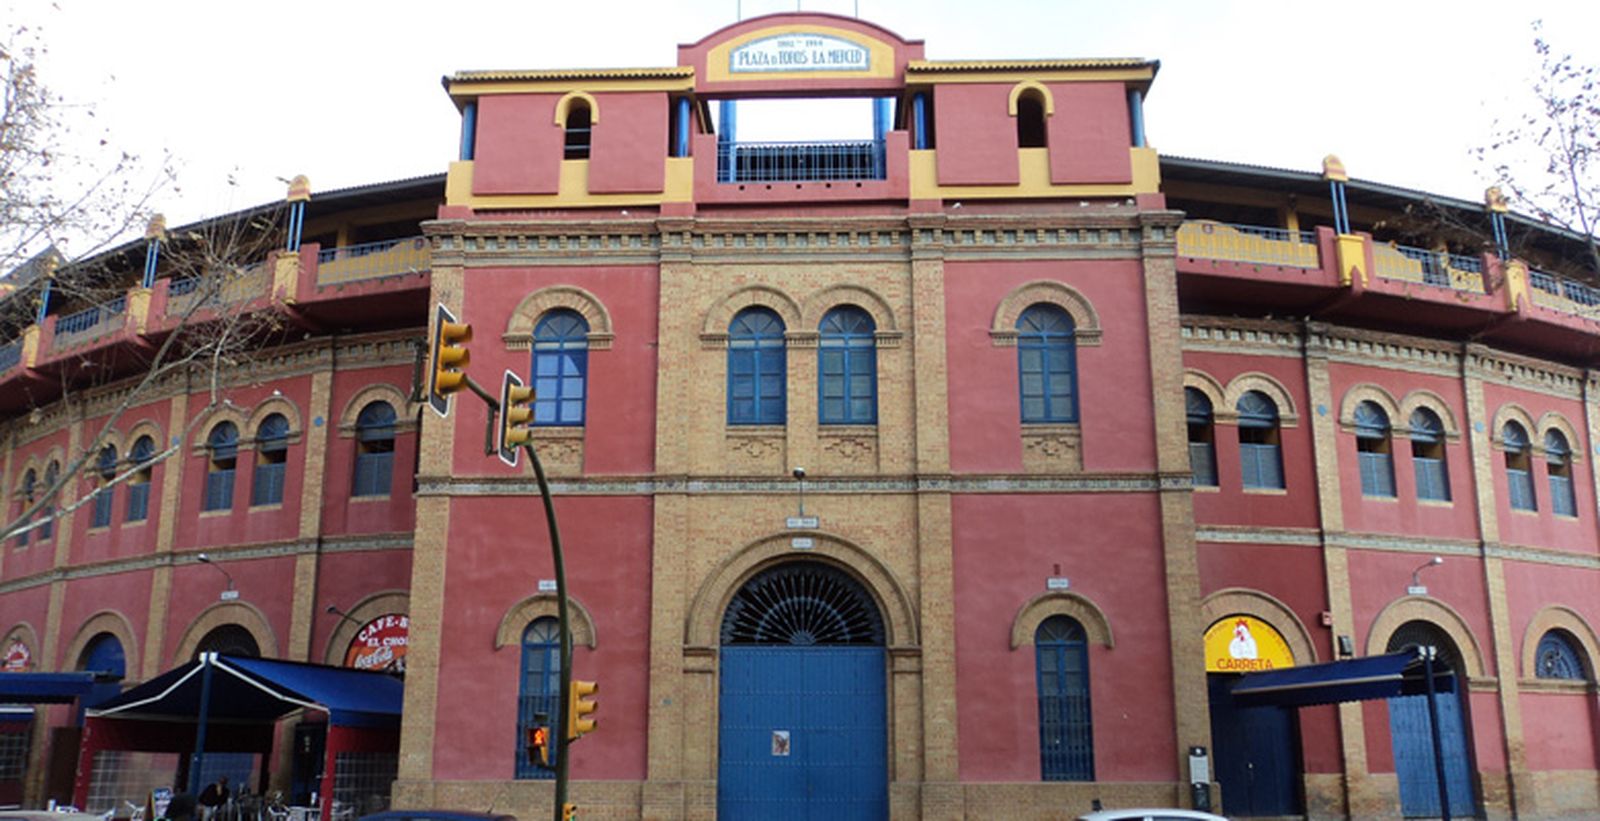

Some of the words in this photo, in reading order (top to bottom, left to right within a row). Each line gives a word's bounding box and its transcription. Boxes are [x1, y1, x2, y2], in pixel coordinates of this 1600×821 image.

[739, 50, 770, 67] PLAZA
[779, 49, 809, 65] TOROS
[812, 49, 826, 65] LA
[827, 48, 862, 65] MERCED
[1216, 657, 1273, 672] CARRETA
